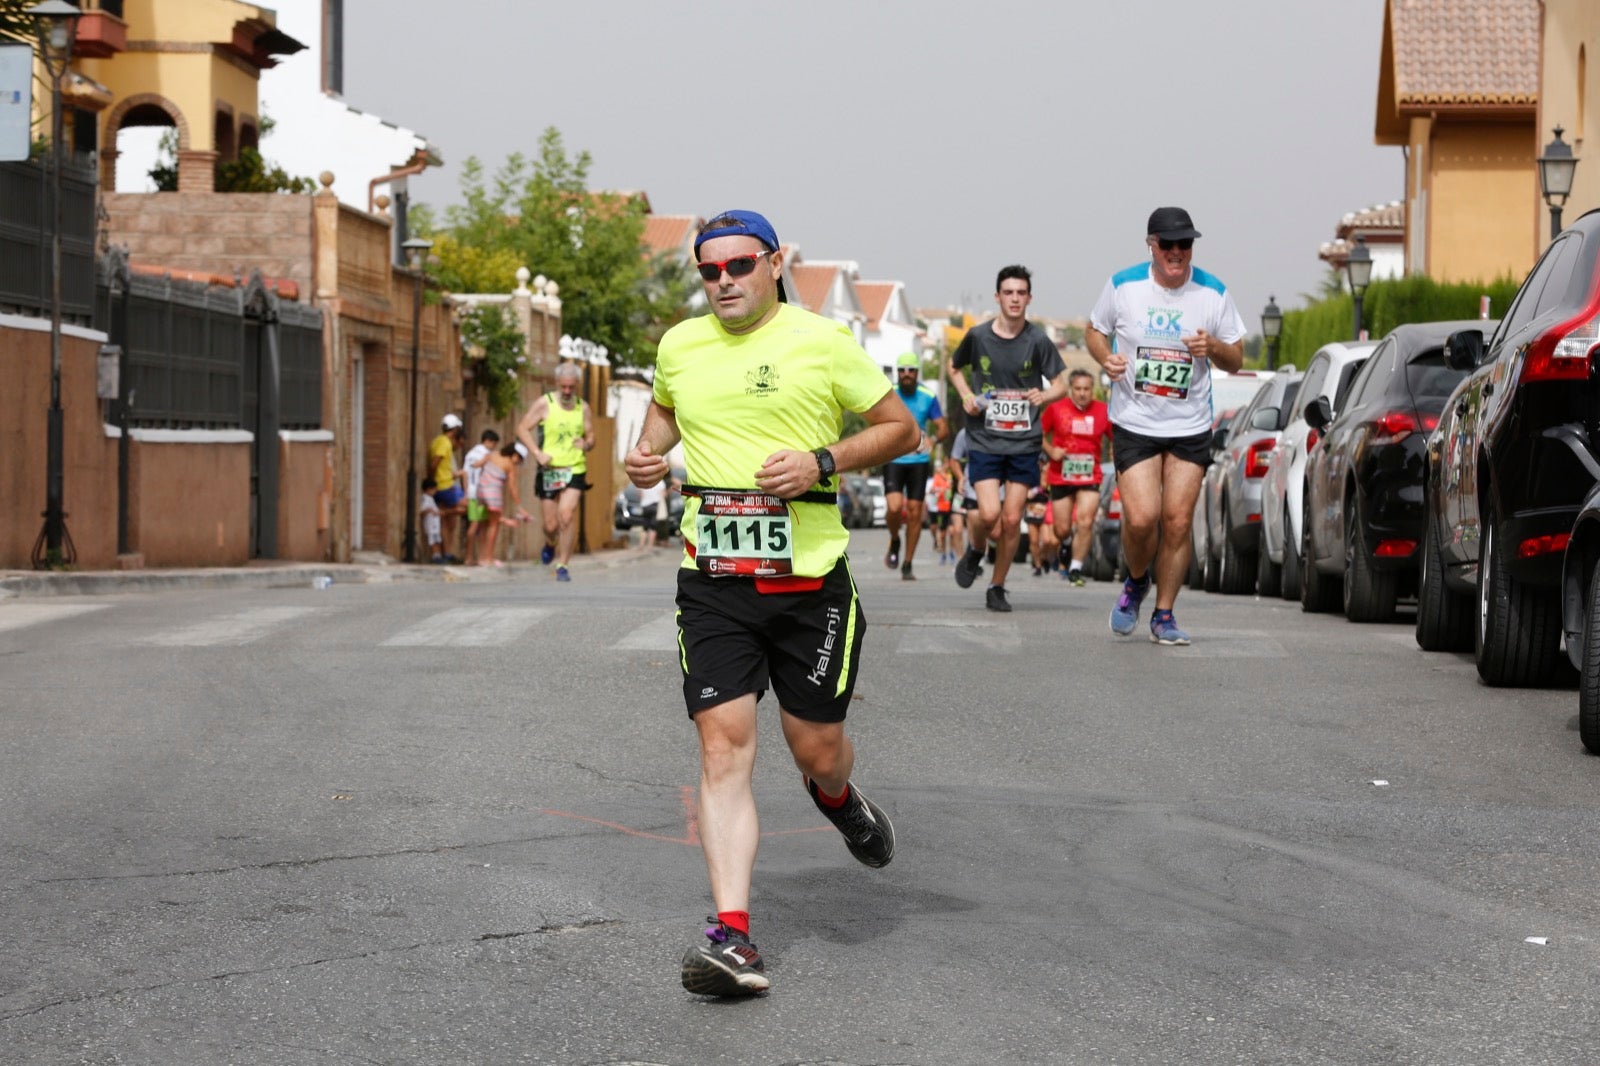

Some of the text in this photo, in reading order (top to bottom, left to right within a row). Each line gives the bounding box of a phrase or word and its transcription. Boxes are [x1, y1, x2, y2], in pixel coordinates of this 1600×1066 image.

[993, 402, 1026, 416] 3051
[715, 495, 731, 506] GRAN
[755, 496, 763, 506] DE
[703, 519, 788, 552] 1115
